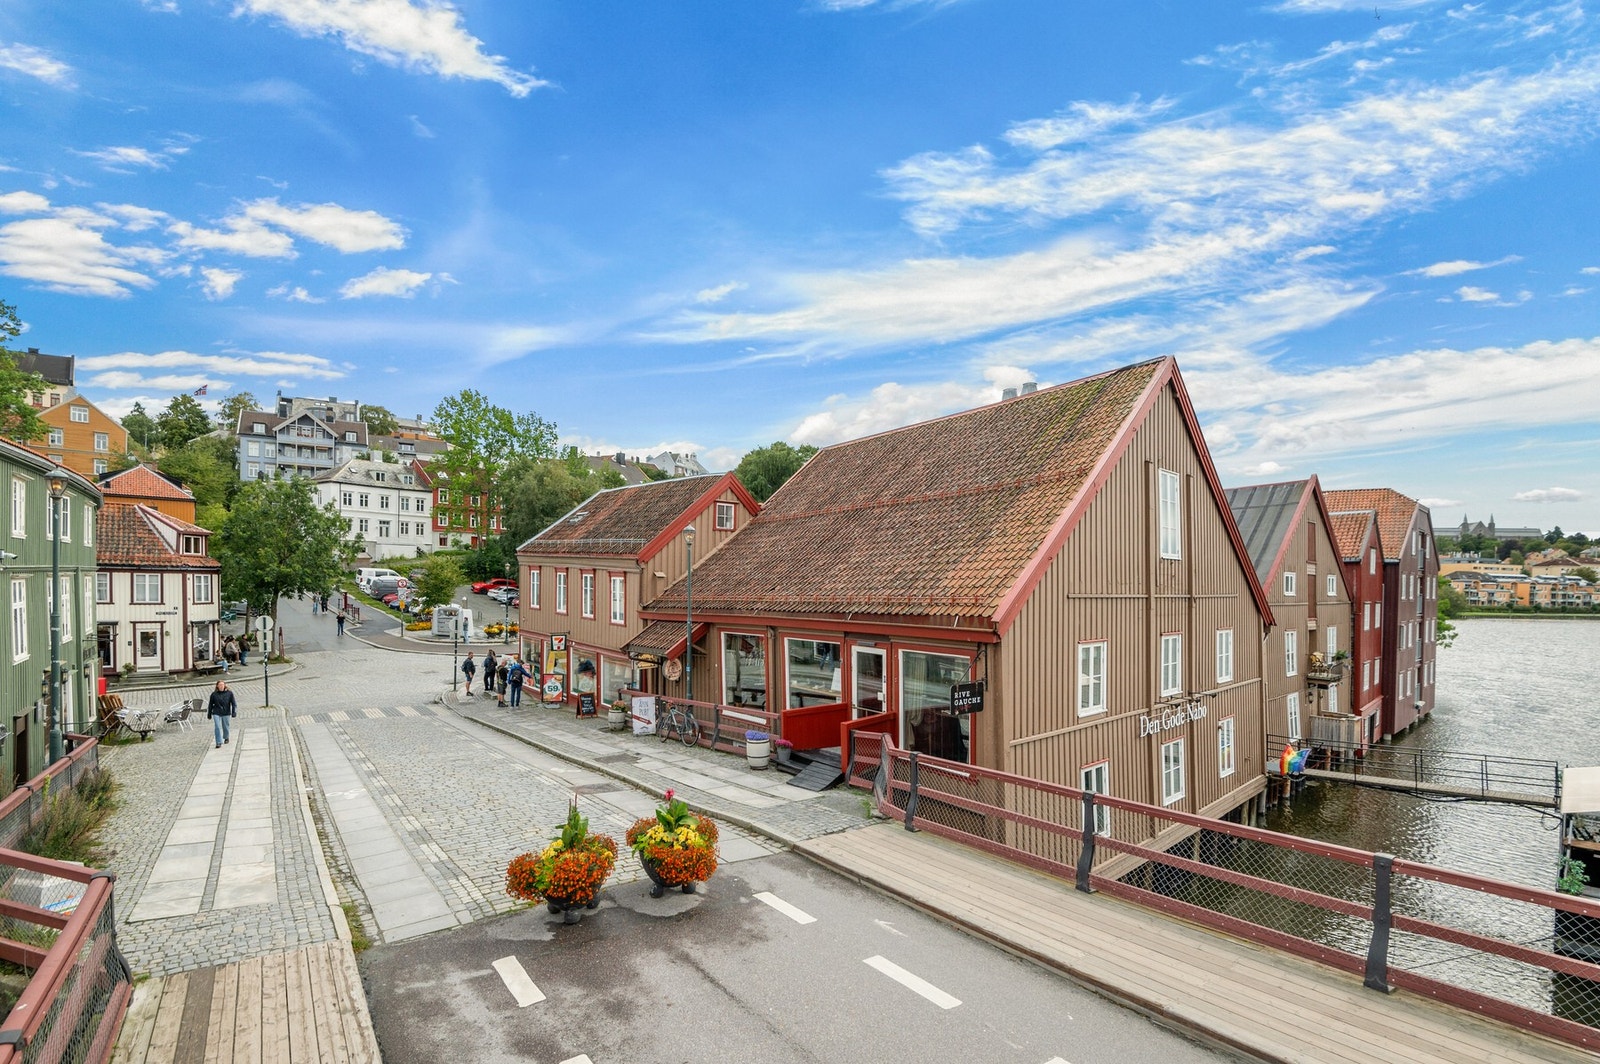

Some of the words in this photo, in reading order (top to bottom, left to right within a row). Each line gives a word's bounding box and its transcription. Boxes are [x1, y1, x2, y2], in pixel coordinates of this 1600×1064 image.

[954, 697, 981, 706] GAUCHE
[1140, 715, 1160, 737] Den
[1162, 705, 1185, 730] Gode
[1187, 702, 1207, 722] Nabo
